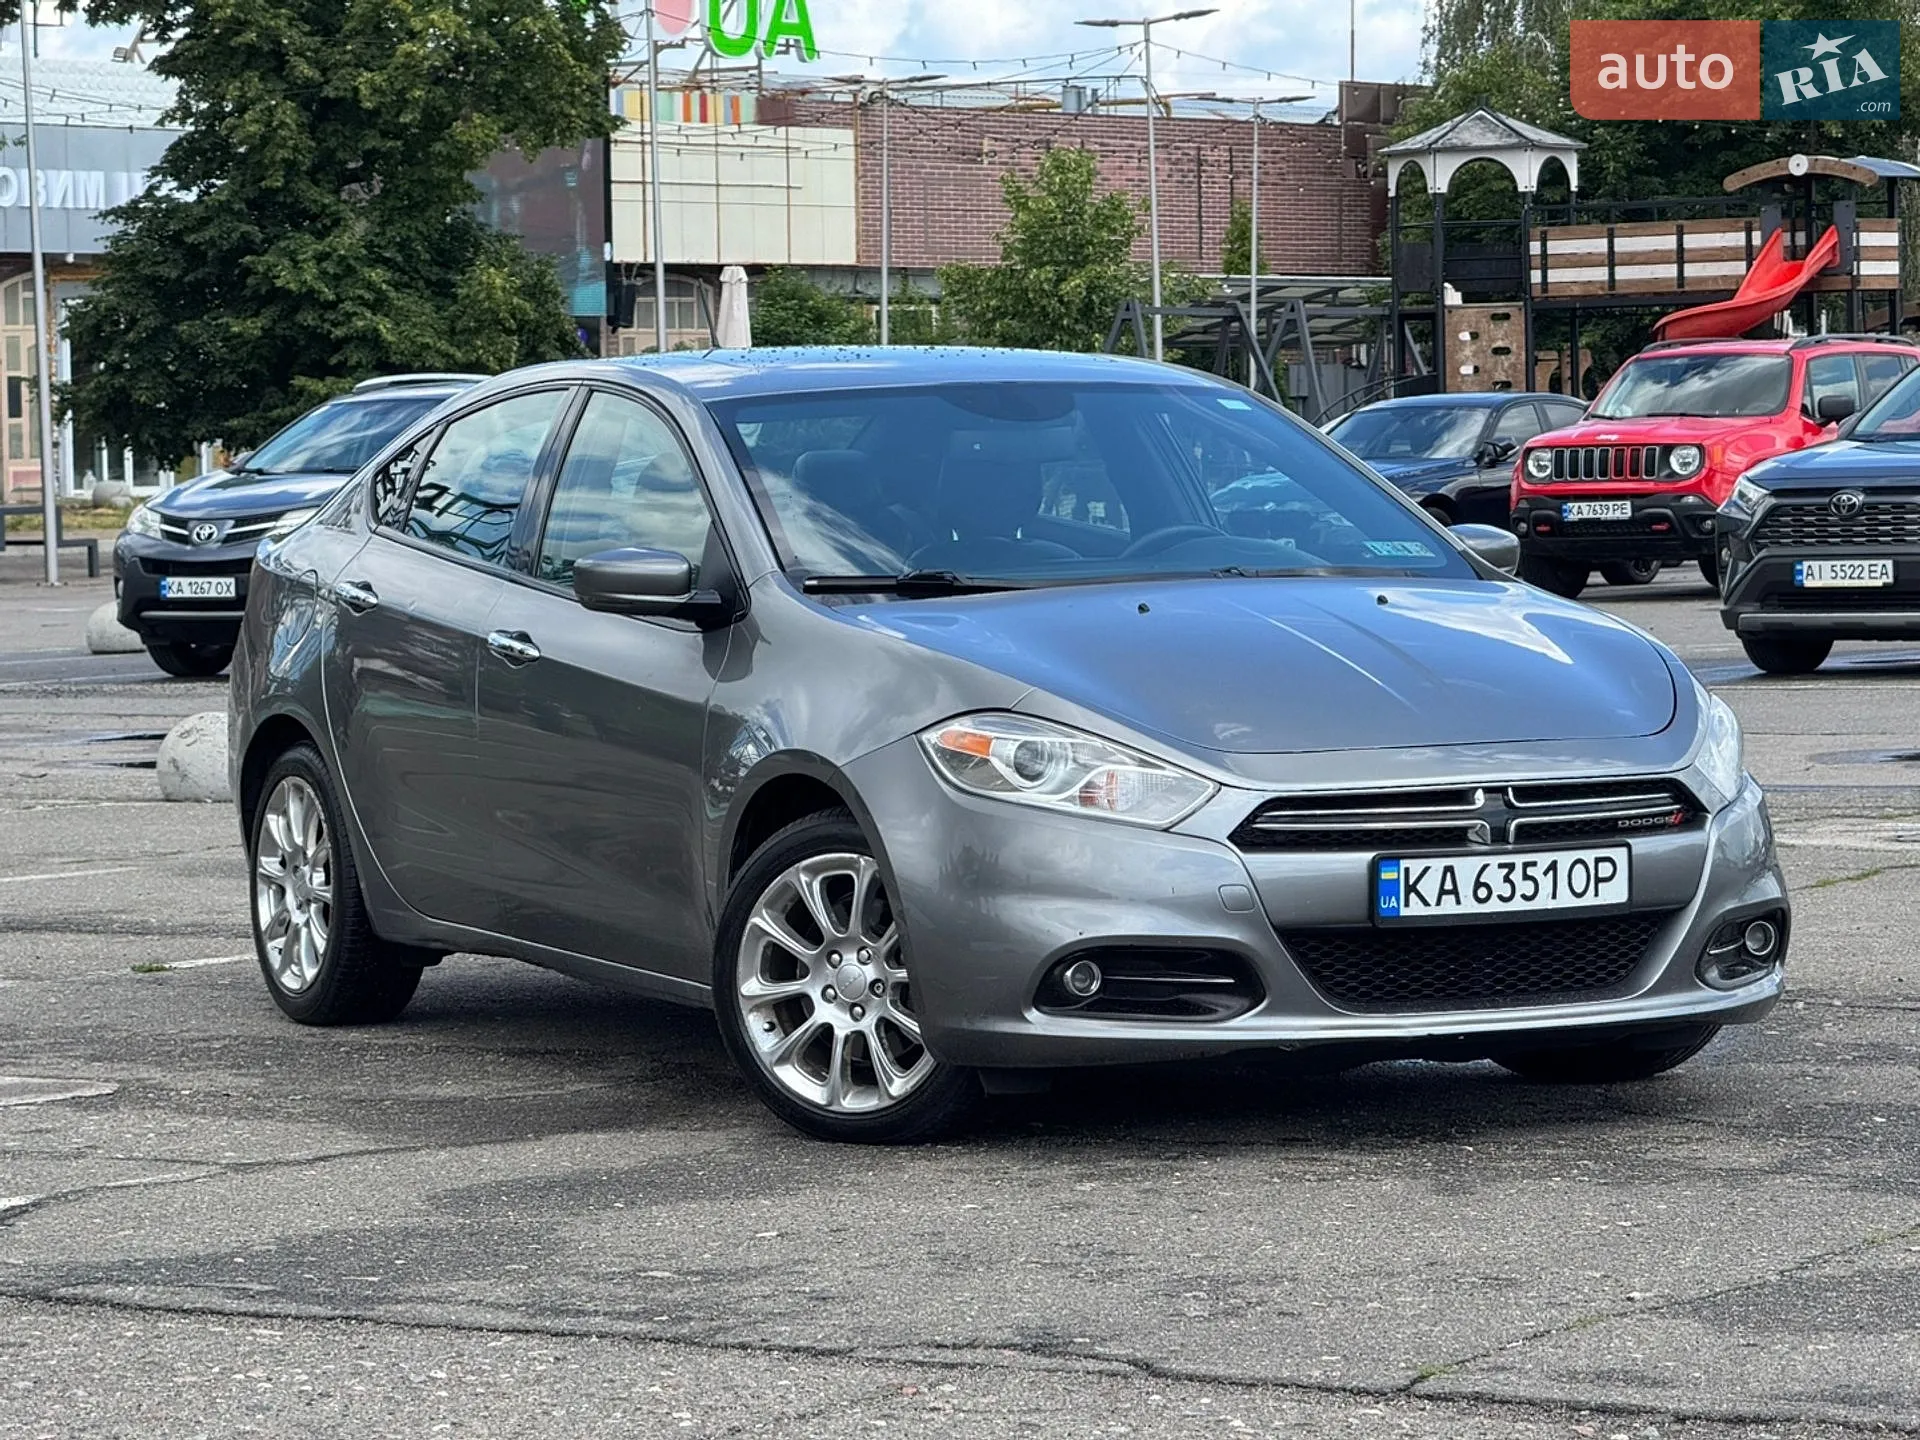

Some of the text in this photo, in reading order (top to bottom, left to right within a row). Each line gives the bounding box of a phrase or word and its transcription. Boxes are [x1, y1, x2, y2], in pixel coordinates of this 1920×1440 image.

[1568, 502, 1629, 516] KA 7639 PE
[1805, 563, 1890, 580] AI 5522 EA
[168, 581, 233, 595] KA 1267 OX
[1617, 816, 1674, 828] DODGE
[1403, 855, 1618, 908] KA 6351 OP
[1380, 895, 1399, 909] UA
